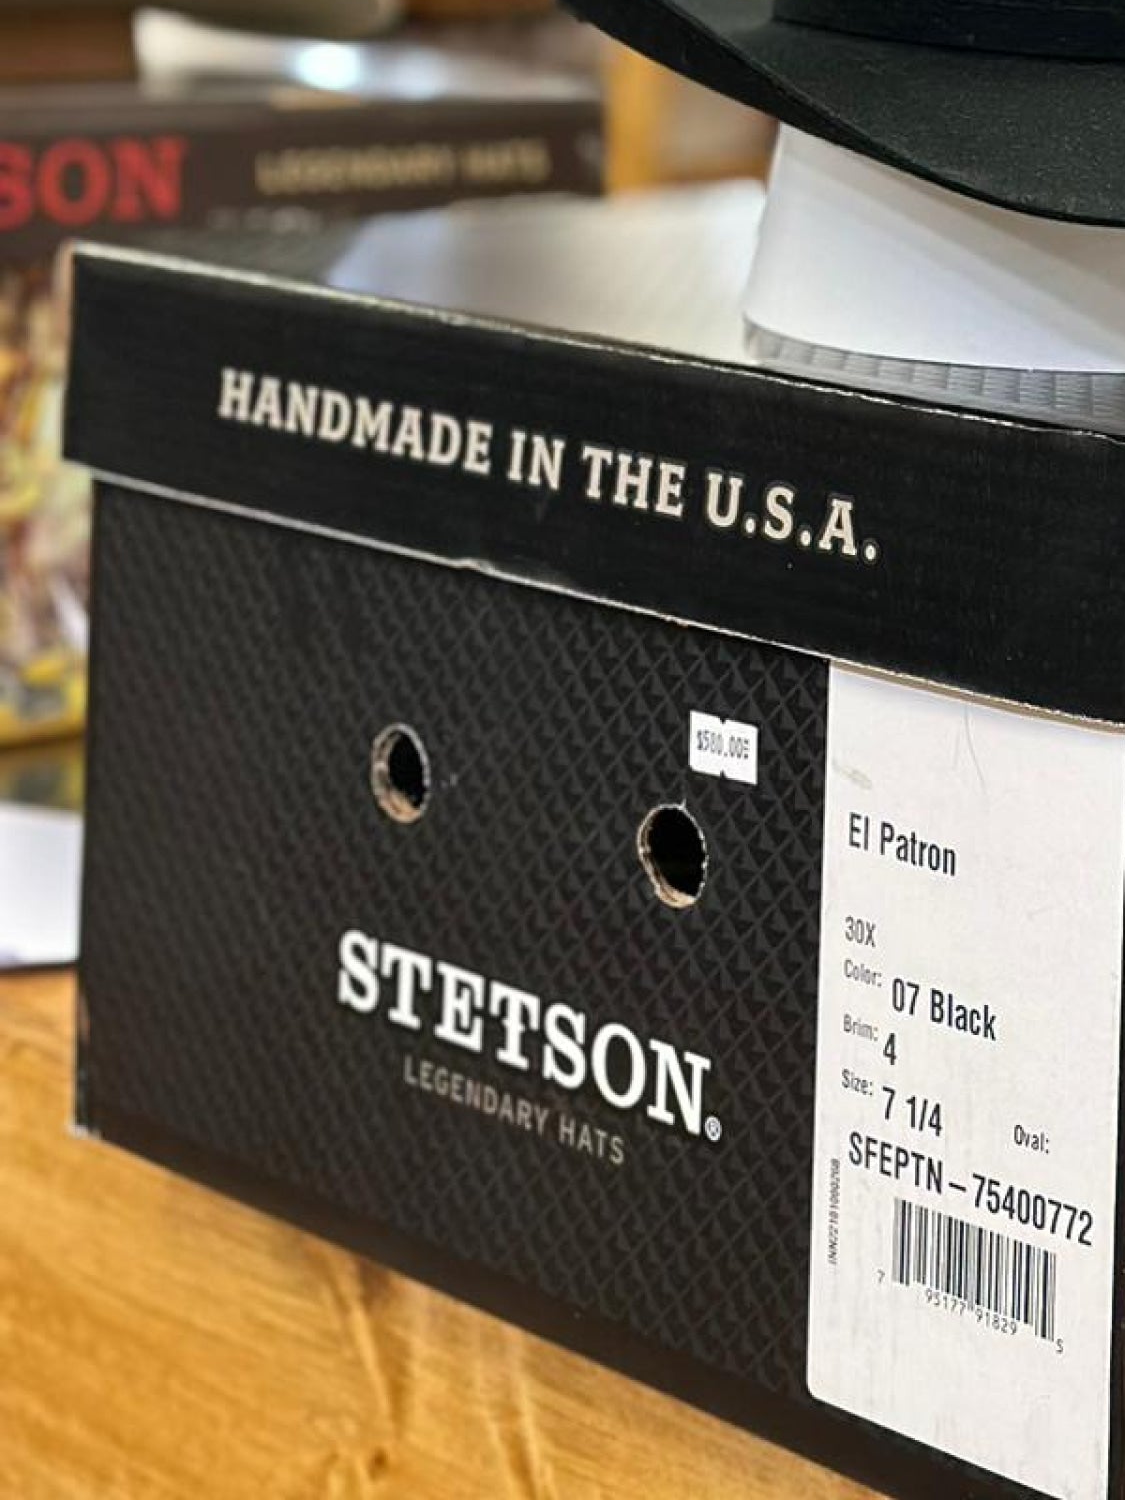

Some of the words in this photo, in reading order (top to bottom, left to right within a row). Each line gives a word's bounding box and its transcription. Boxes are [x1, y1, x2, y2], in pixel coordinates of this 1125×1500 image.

[218, 366, 492, 476] HANDMADE
[507, 428, 566, 491] IN
[581, 444, 686, 517] THE
[707, 470, 877, 562] U.S.A.
[849, 811, 870, 851] El
[880, 820, 956, 877] Patron
[844, 914, 876, 948] 30X
[843, 958, 882, 987] Color:
[892, 978, 920, 1016] 07
[930, 987, 997, 1041] Black
[842, 1013, 878, 1041] Brim:
[882, 1032, 897, 1066] 4
[404, 1055, 550, 1136] LEGENDARY
[557, 1115, 625, 1166] HATS
[841, 1068, 873, 1096] Size:
[882, 1086, 896, 1121] 7
[905, 1095, 943, 1137] 1/4
[1013, 1124, 1050, 1154] Oval:
